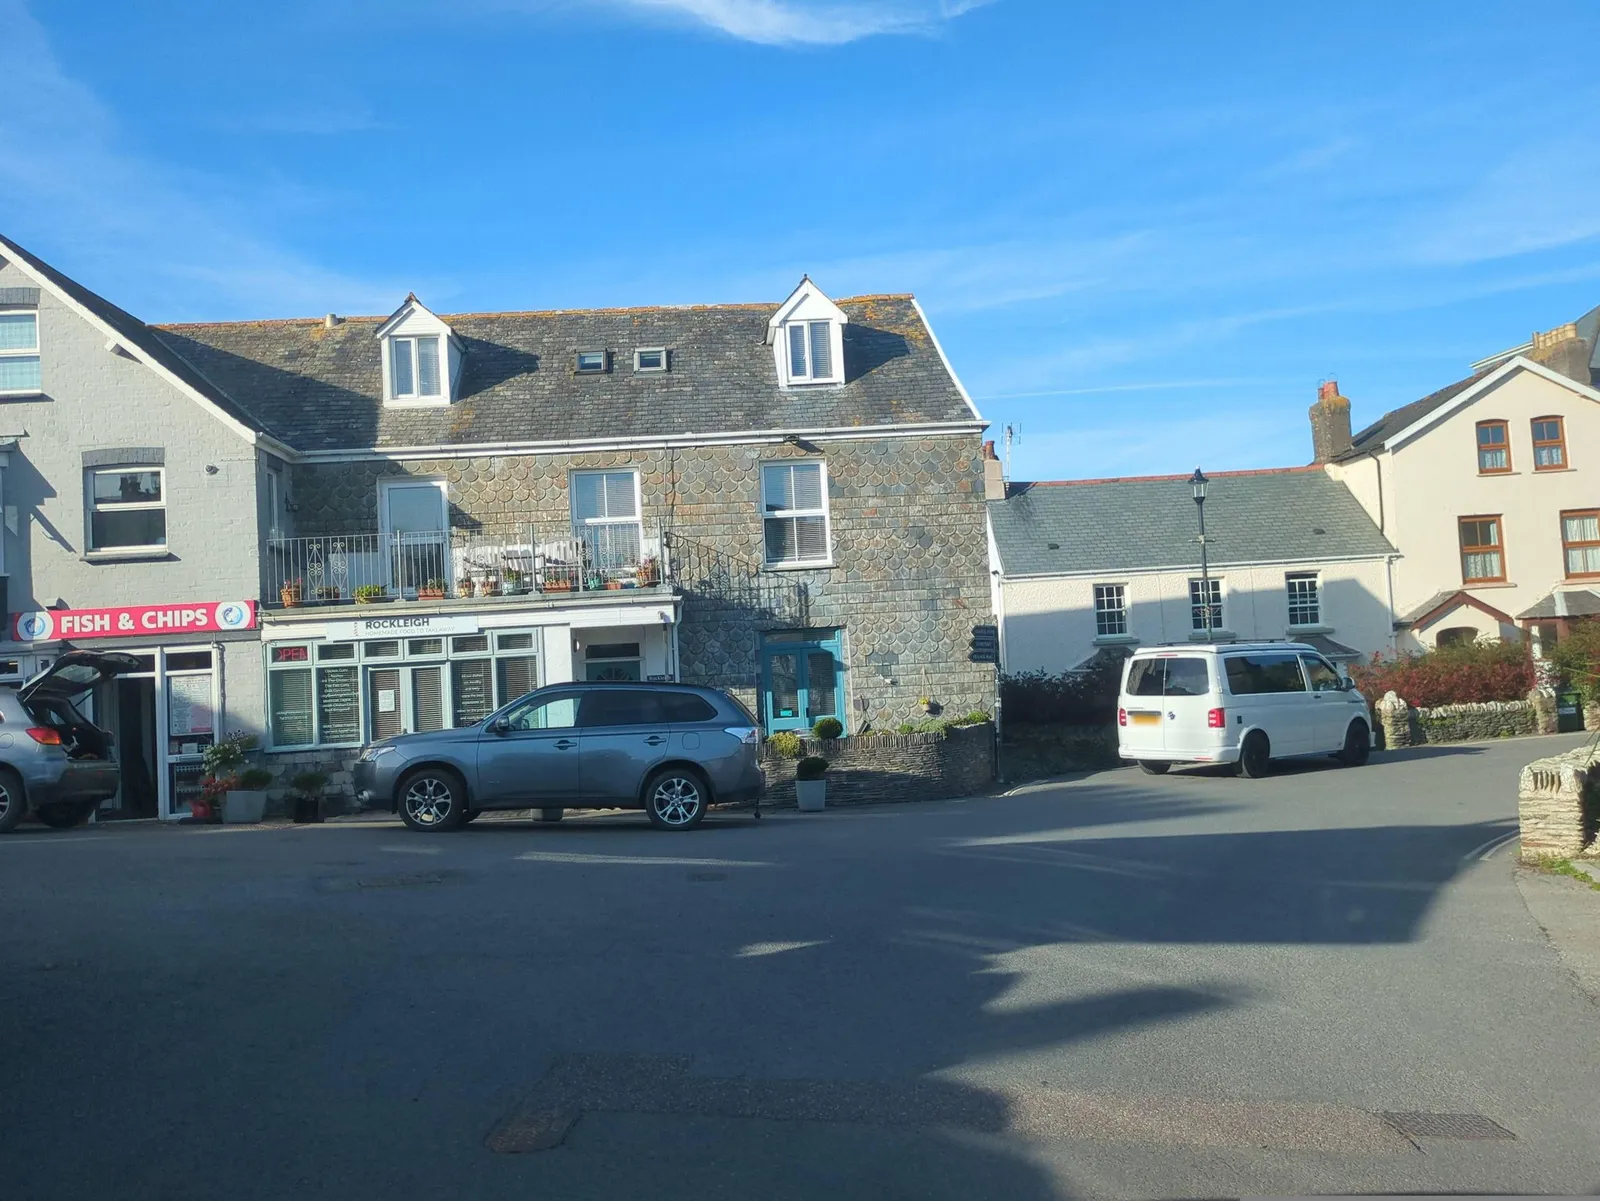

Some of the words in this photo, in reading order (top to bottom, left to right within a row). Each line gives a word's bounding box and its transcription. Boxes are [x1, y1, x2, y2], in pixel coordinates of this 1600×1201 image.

[60, 613, 110, 633] FISH
[118, 613, 135, 631] &
[141, 608, 208, 629] CHIPS
[365, 617, 430, 629] ROCKLEIGH
[365, 629, 398, 637] HOMEMADE
